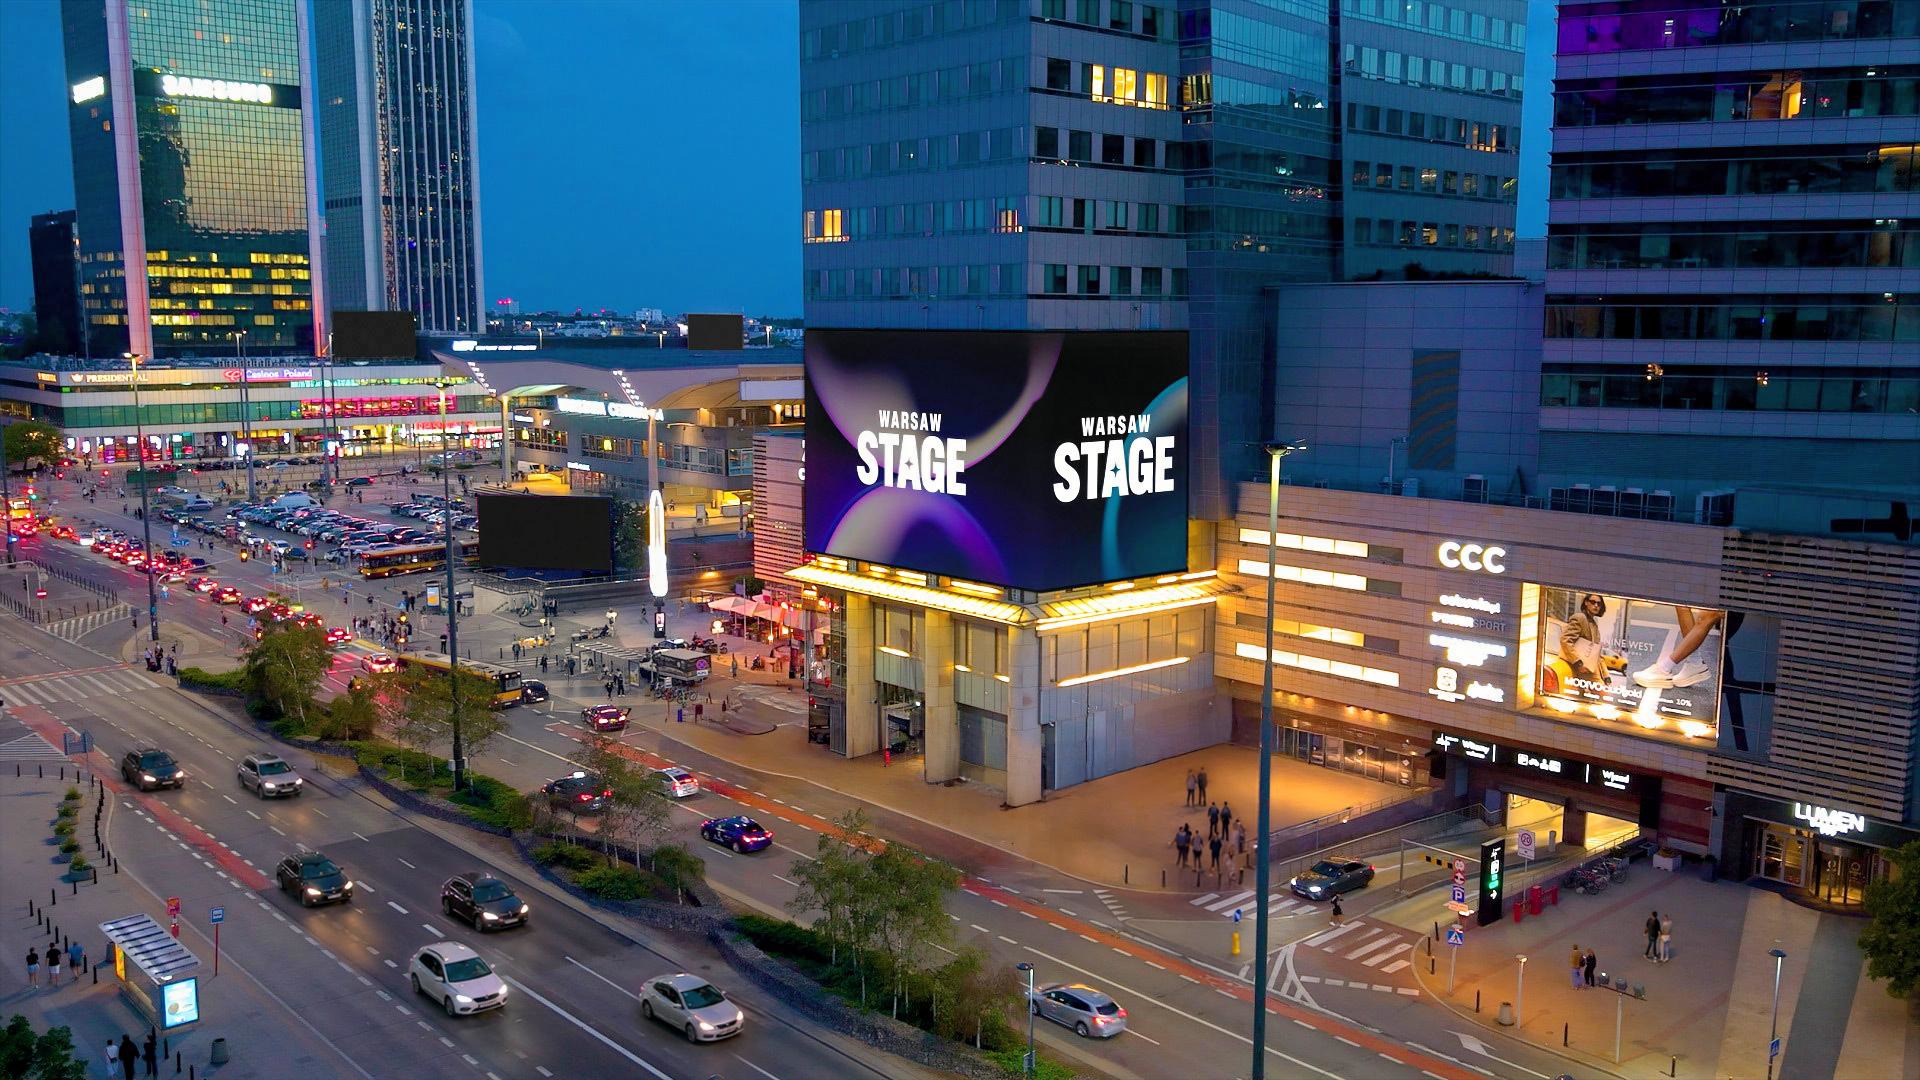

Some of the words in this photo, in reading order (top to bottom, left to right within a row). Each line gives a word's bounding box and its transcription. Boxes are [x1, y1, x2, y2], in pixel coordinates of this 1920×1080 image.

[86, 374, 148, 382] PRESIDENTAL
[283, 369, 312, 378] Poland
[879, 410, 942, 432] WARSAW
[1081, 414, 1151, 436] WARSAW
[857, 431, 967, 496] STAGE
[1053, 436, 1175, 503] STAGE
[1438, 541, 1506, 574] CCC
[1602, 637, 1627, 648] NINE
[1629, 640, 1655, 652] WEST
[1795, 802, 1865, 832] LUMEN
